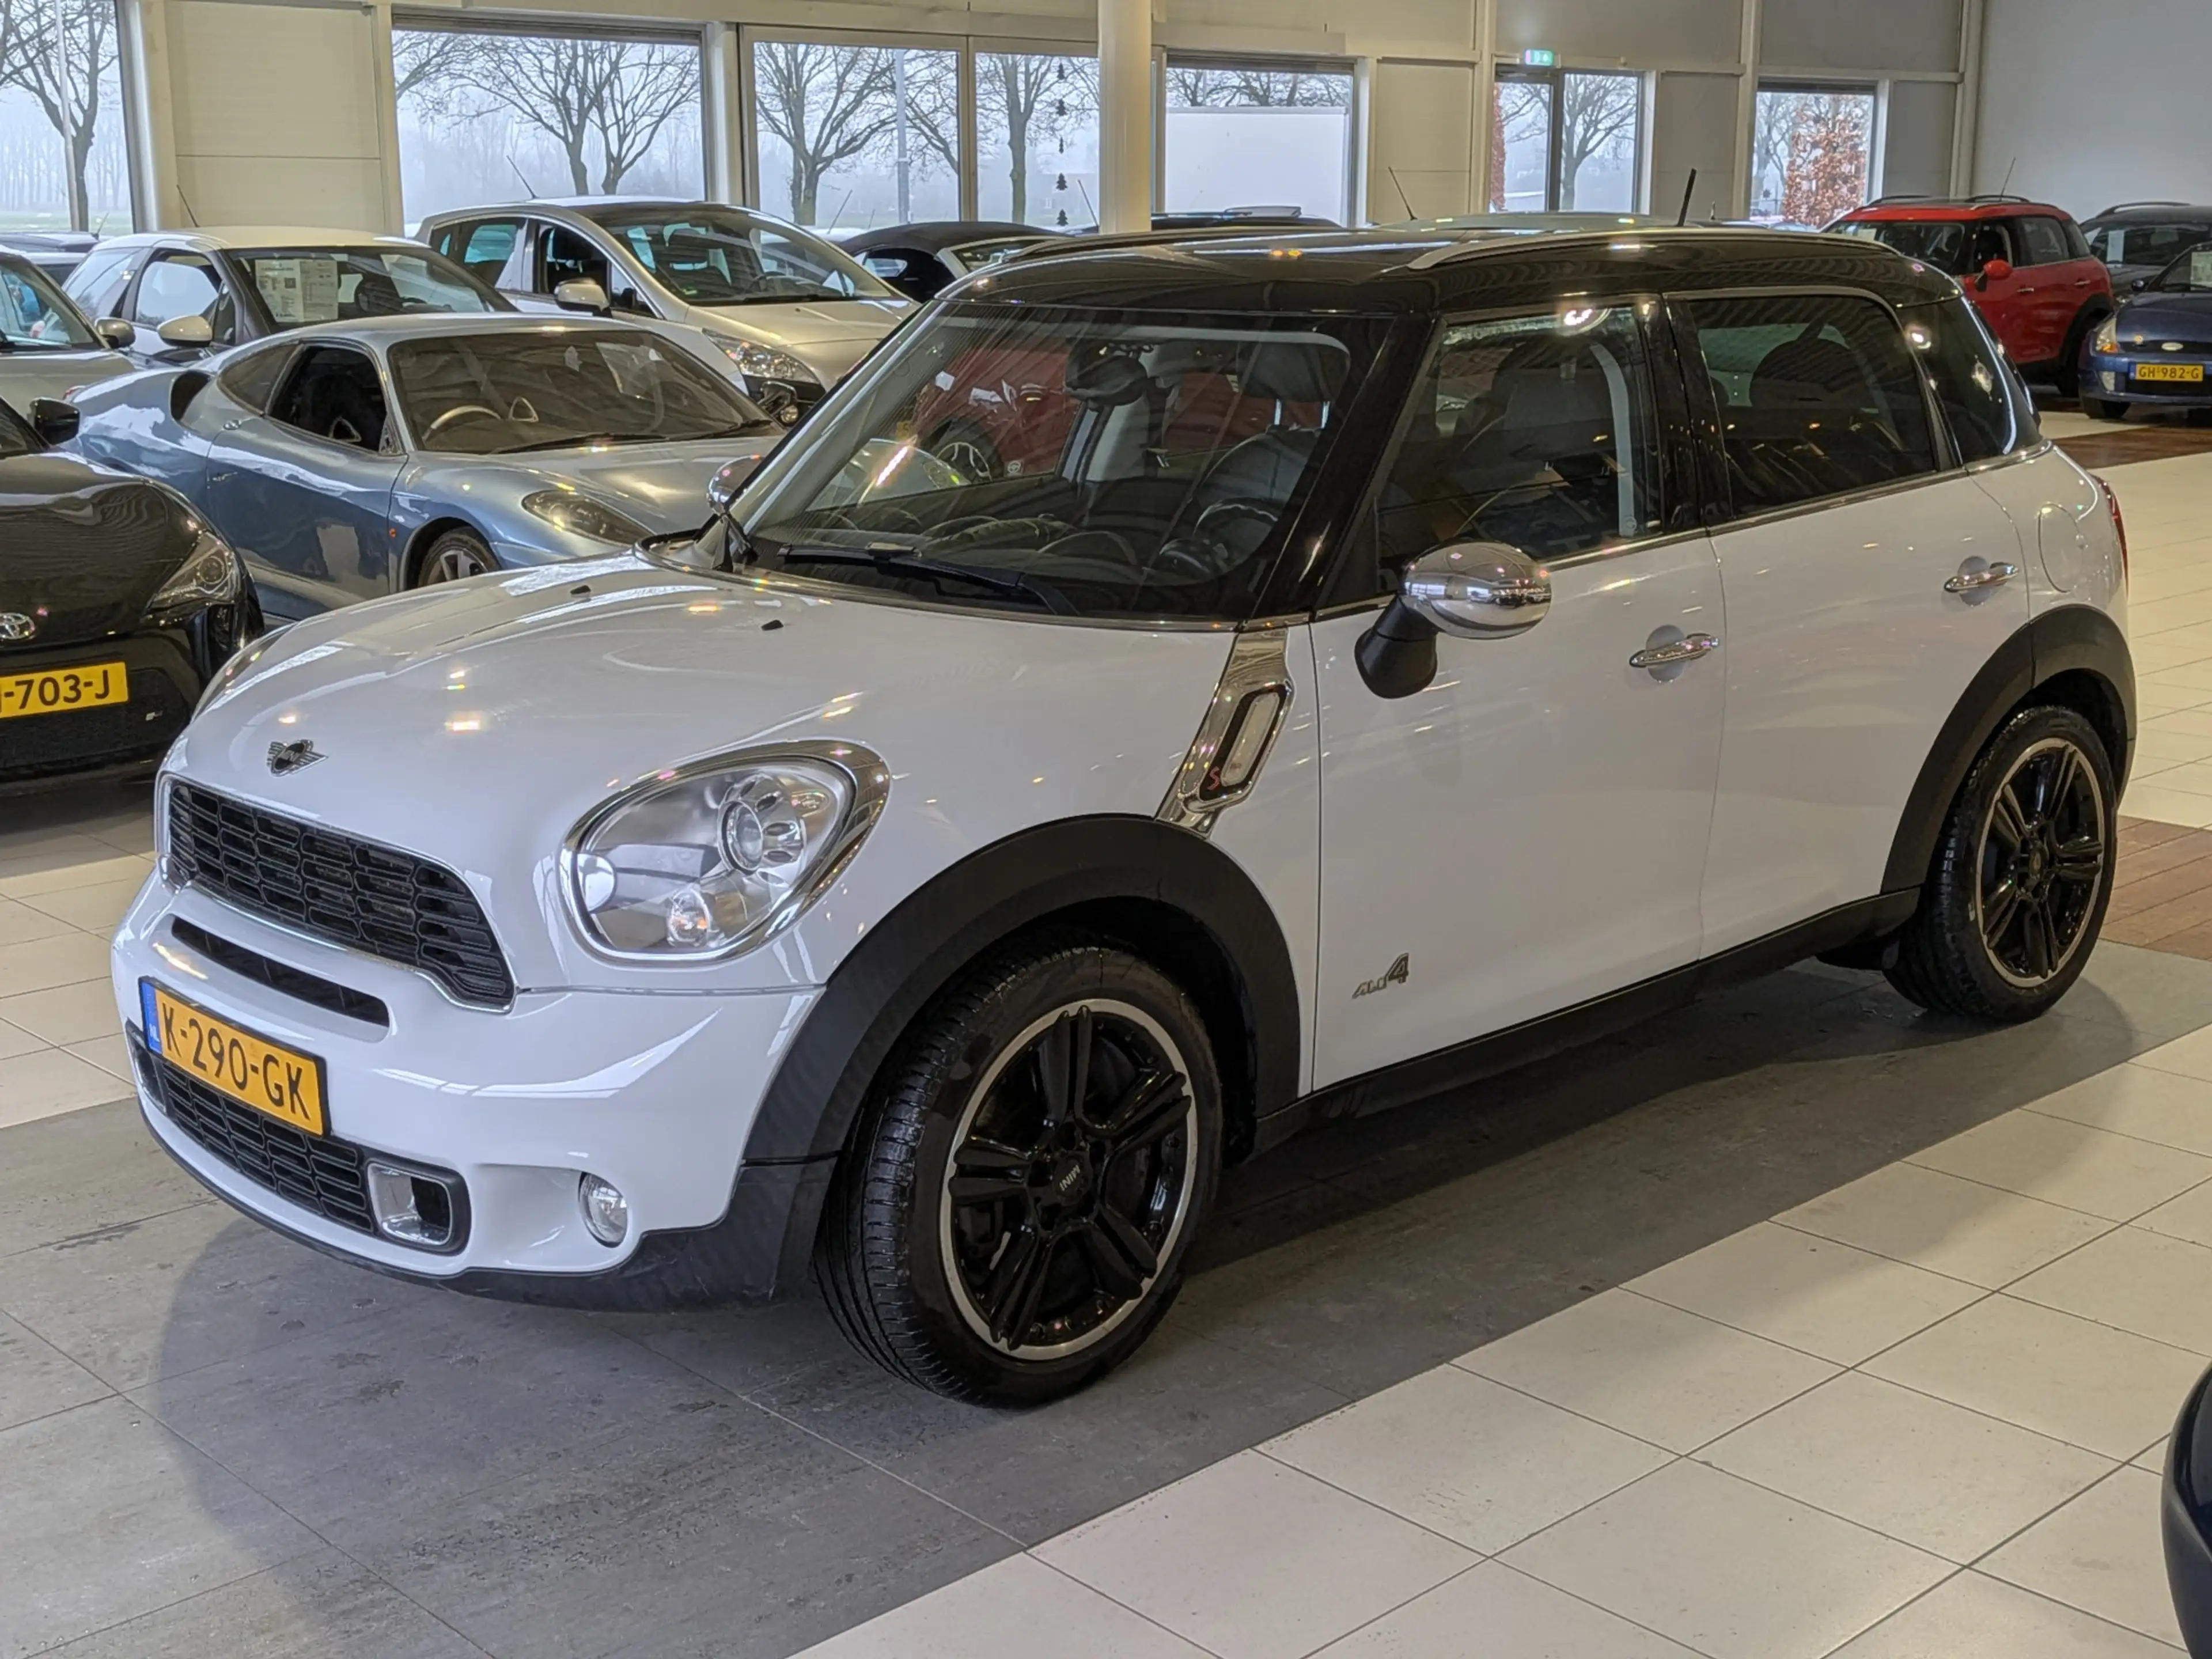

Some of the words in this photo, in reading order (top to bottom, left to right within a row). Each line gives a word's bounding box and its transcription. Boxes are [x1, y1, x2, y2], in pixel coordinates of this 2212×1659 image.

[2139, 366, 2199, 378] GH-982-G
[0, 669, 109, 713] -703-J
[162, 1002, 311, 1121] K-290-GK
[1059, 1164, 1081, 1191] MINI
